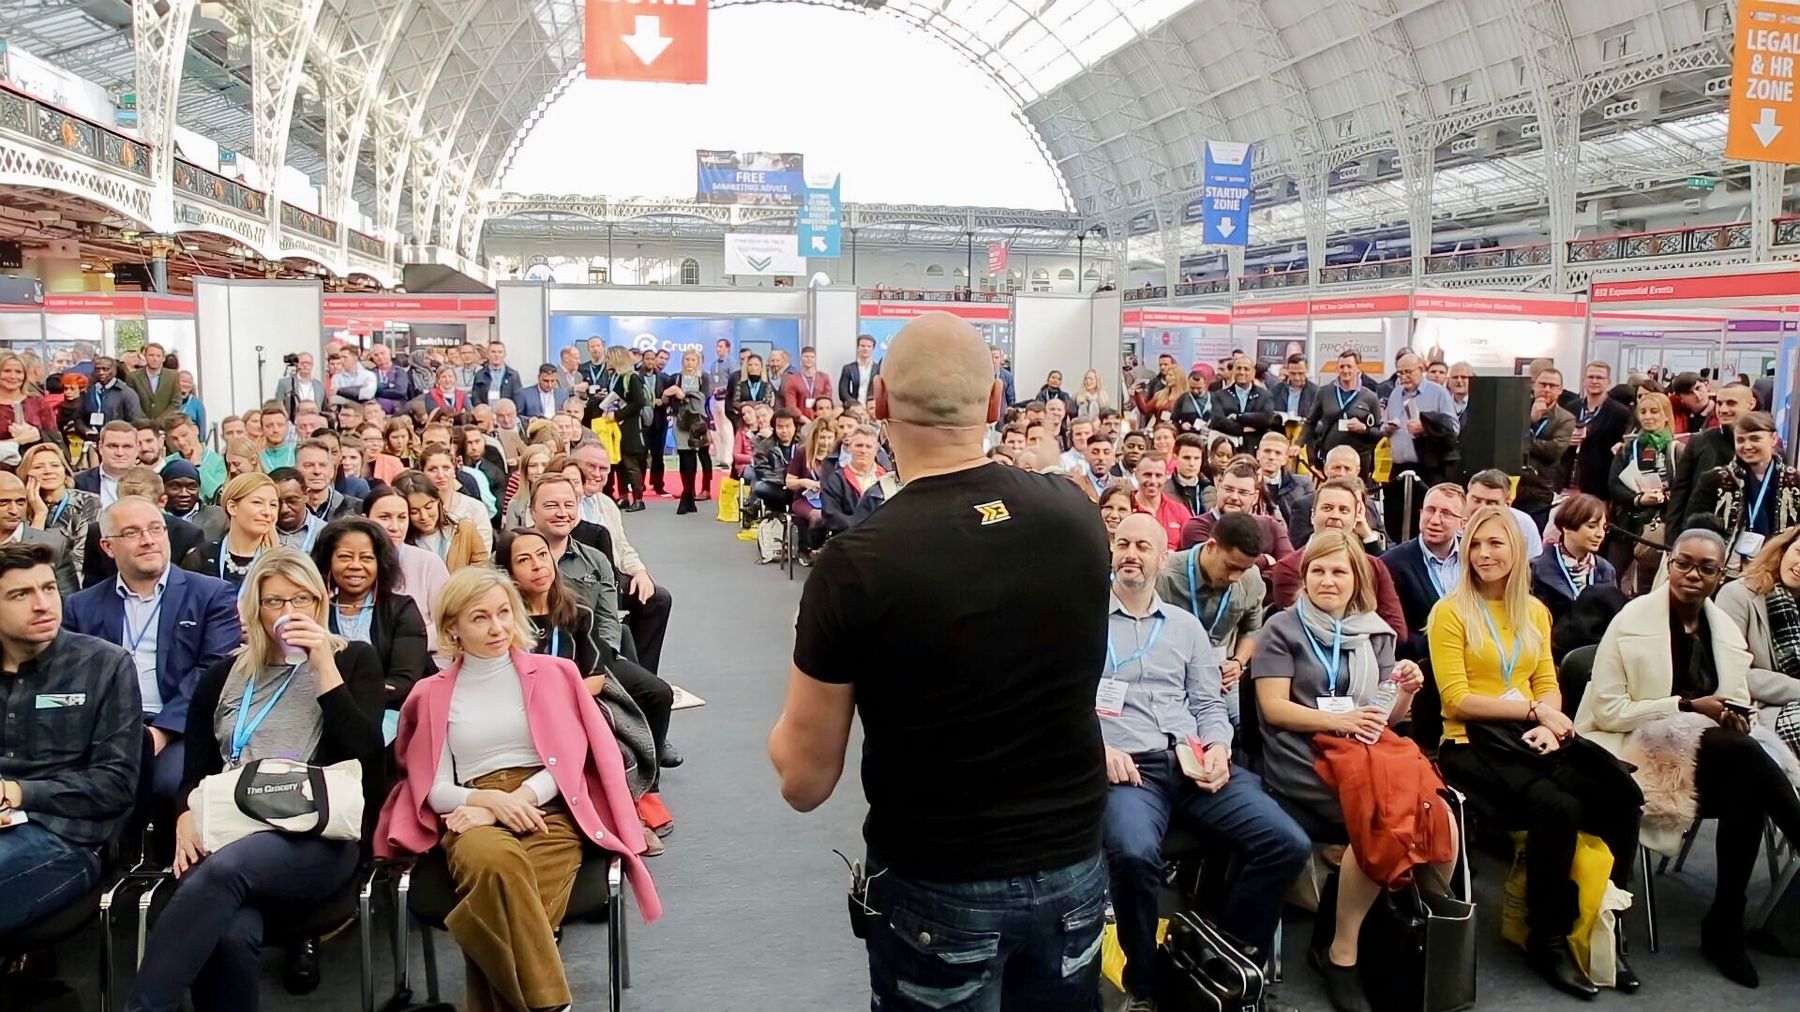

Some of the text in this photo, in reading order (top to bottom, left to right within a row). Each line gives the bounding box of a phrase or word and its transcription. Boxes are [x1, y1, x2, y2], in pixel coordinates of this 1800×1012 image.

[1747, 29, 1800, 55] LEGAL
[1751, 54, 1793, 78] & HR
[1746, 78, 1793, 102] ZONE
[736, 171, 765, 183] FREE
[1205, 186, 1249, 199] STARTUP
[1213, 199, 1240, 211] ZONE
[1649, 286, 1674, 294] Events
[1319, 343, 1341, 352] PPC
[247, 786, 263, 795] The
